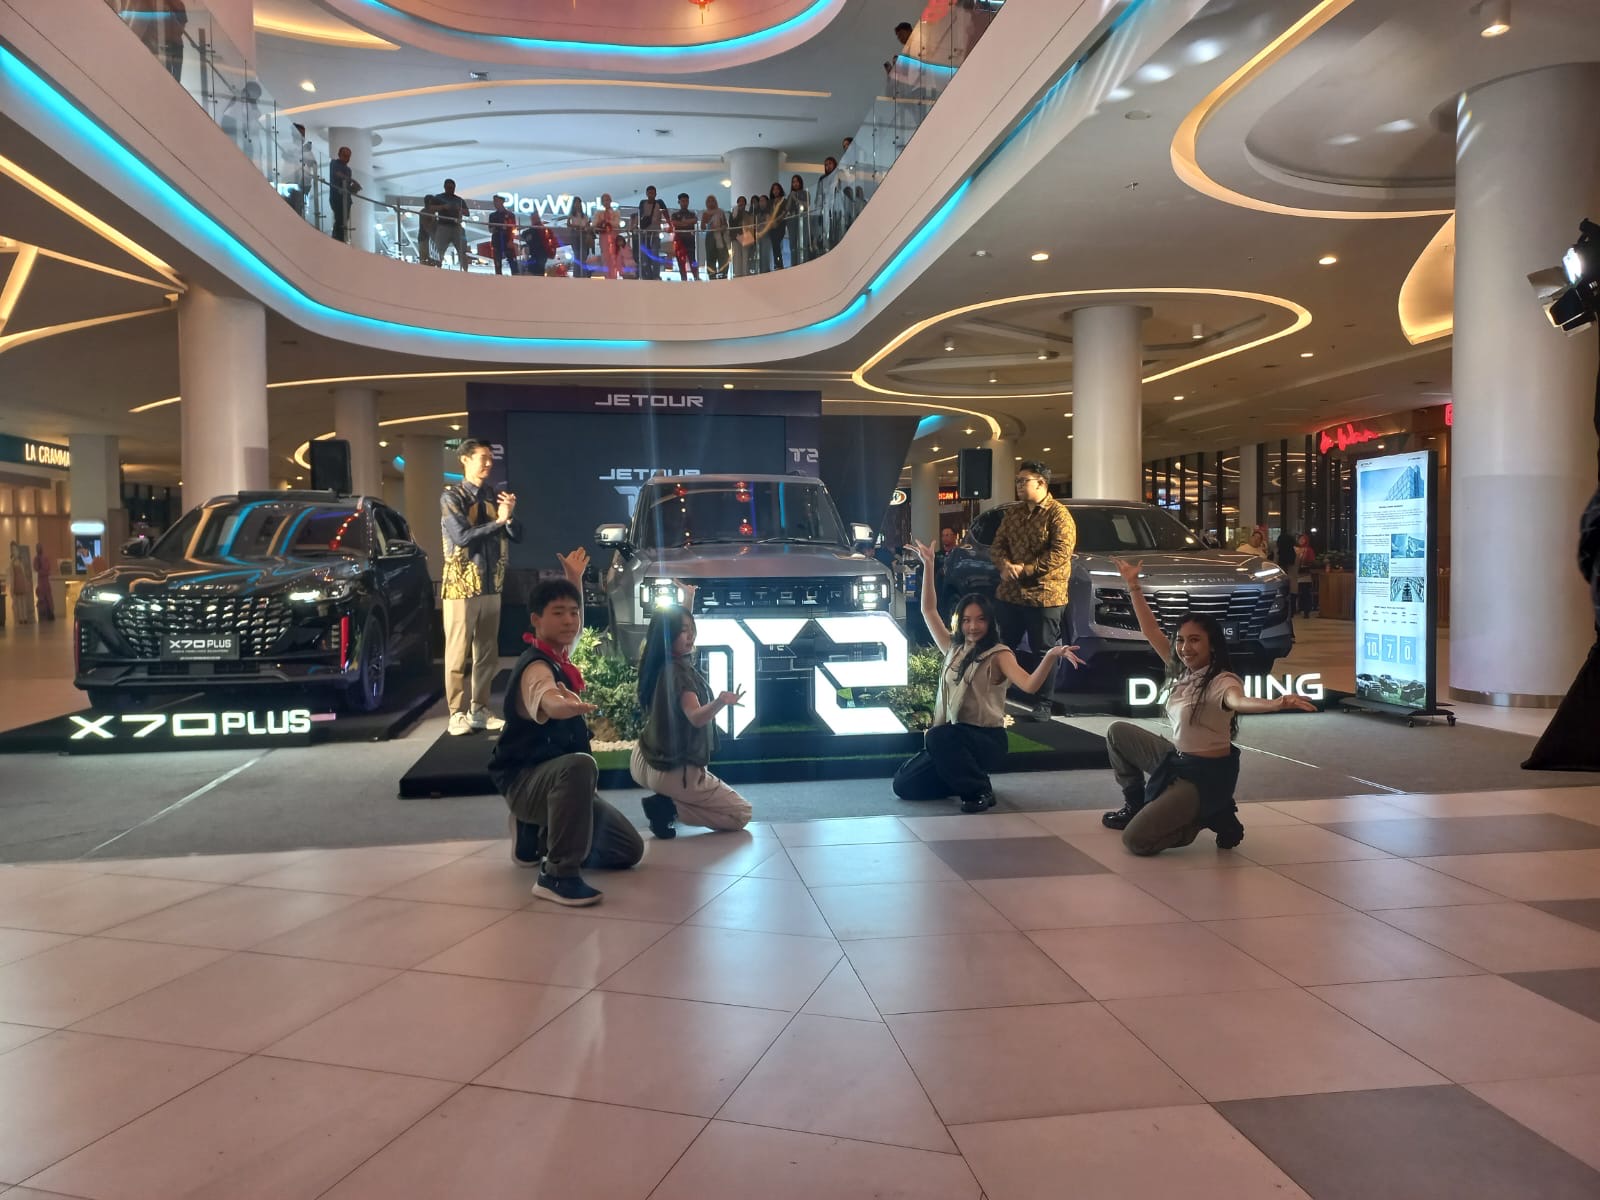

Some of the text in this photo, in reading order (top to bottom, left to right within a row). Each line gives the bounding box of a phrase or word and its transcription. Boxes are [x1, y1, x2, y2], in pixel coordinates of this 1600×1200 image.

[497, 192, 620, 216] PlayWrs
[595, 394, 703, 407] JETOUR
[25, 443, 36, 461] LA
[788, 447, 819, 463] T2
[169, 639, 232, 649] X70 PLUS
[1128, 672, 1324, 706] DING
[68, 709, 311, 740] X70 PLUS
